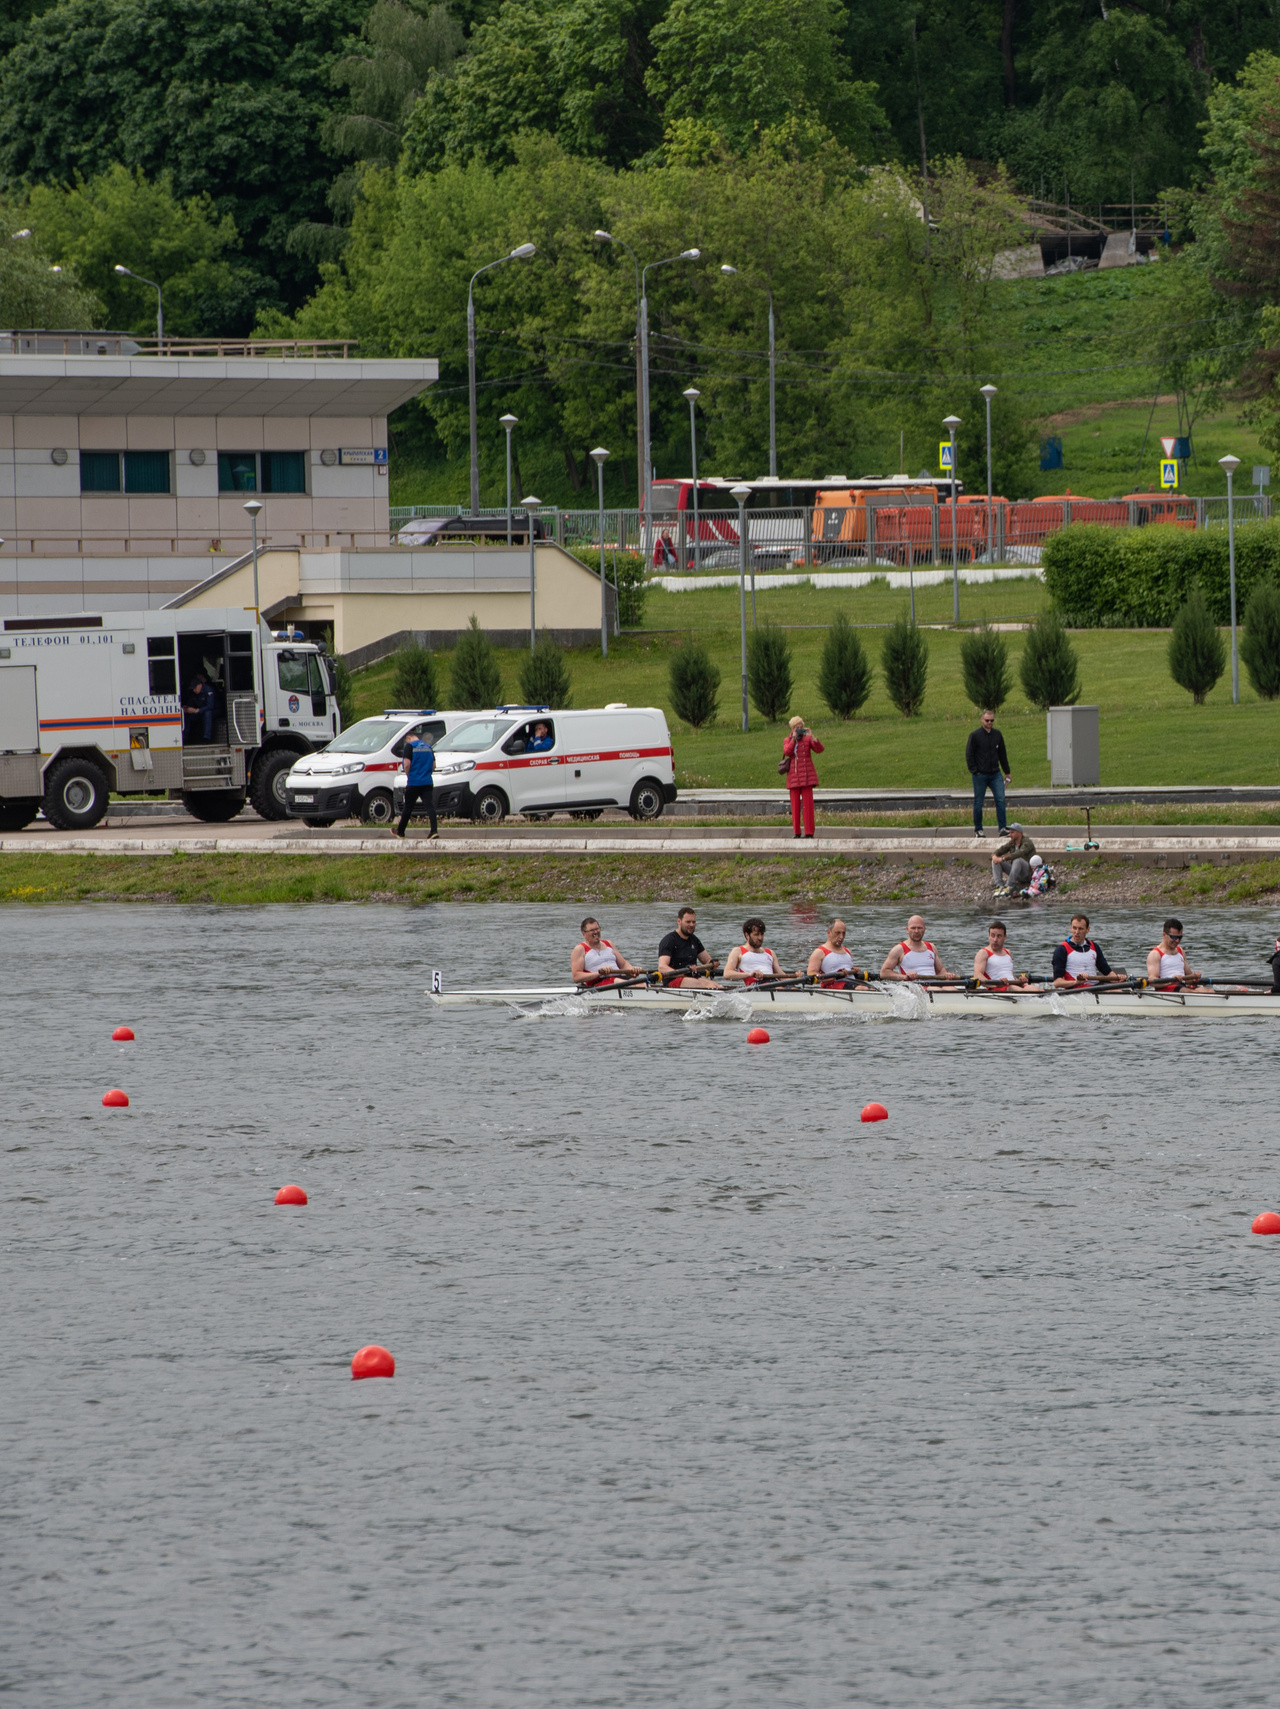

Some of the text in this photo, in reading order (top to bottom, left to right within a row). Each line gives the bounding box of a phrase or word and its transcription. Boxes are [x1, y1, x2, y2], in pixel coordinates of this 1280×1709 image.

[377, 450, 384, 459] 2
[13, 635, 114, 647] ТЕЛЕФОН 01,101
[121, 708, 136, 716] НА
[434, 972, 440, 990] 5
[623, 990, 634, 998] RUS
